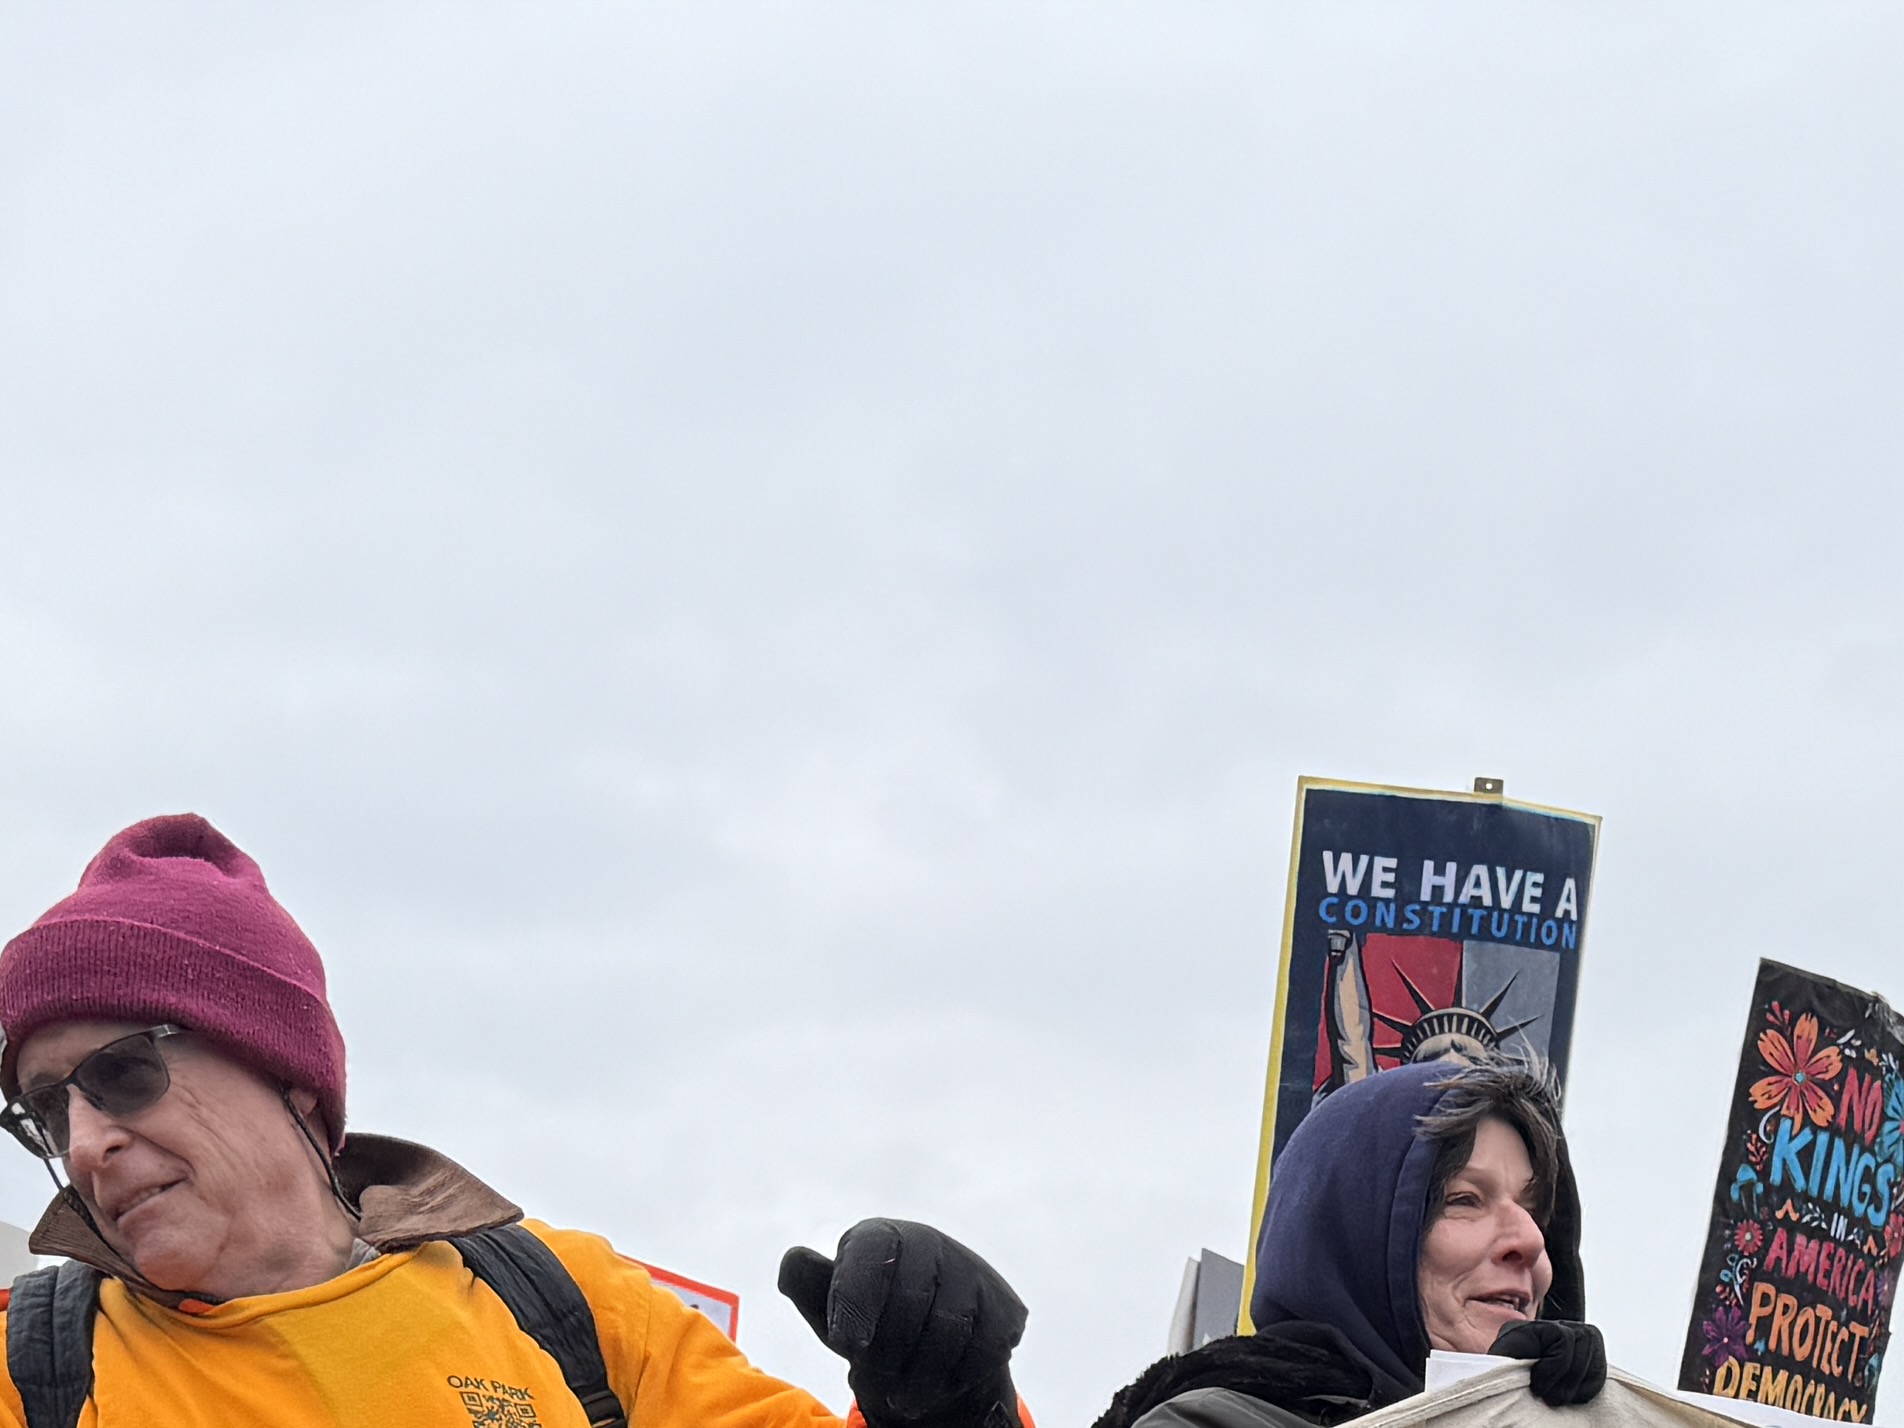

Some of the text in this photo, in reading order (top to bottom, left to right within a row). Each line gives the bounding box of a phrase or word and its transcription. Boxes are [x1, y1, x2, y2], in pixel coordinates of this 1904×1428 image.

[1318, 896, 1578, 950] CONSTITUTION
[1322, 850, 1579, 921] WE HAVE A
[1835, 1066, 1883, 1147] NO
[1769, 1116, 1895, 1231] KINGS
[1830, 1212, 1849, 1242] IN
[1763, 1227, 1876, 1317] AMERICA
[1745, 1281, 1870, 1384] PROTECT
[446, 1374, 535, 1401] OAK PARK
